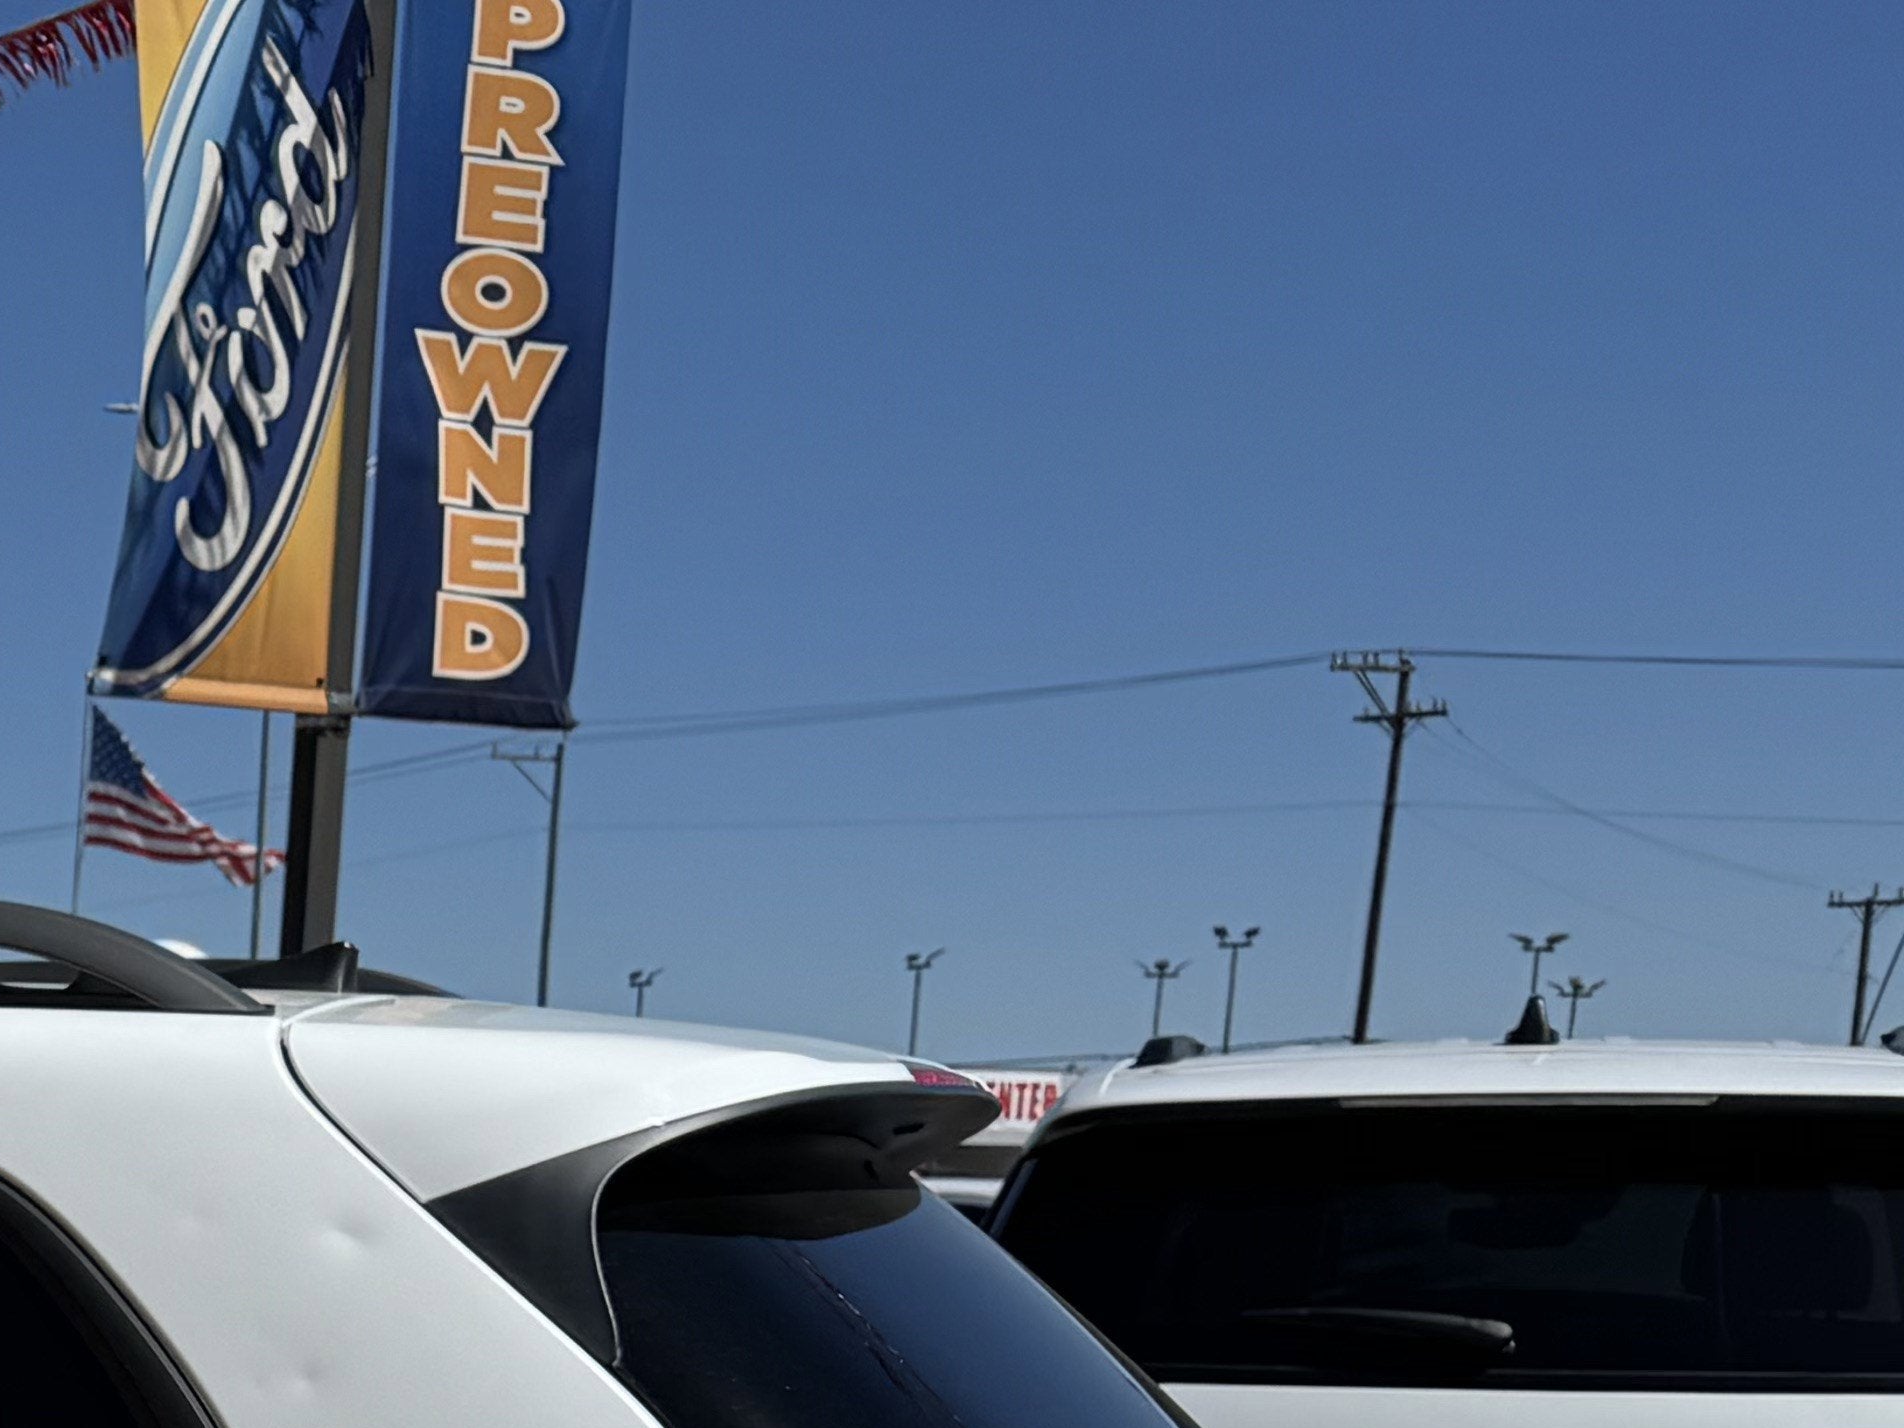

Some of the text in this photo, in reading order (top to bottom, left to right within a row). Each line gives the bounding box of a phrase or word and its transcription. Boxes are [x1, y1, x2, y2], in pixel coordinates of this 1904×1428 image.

[135, 32, 348, 571] Ford
[414, 0, 568, 680] PREOWNED
[987, 1080, 1058, 1121] NTER
